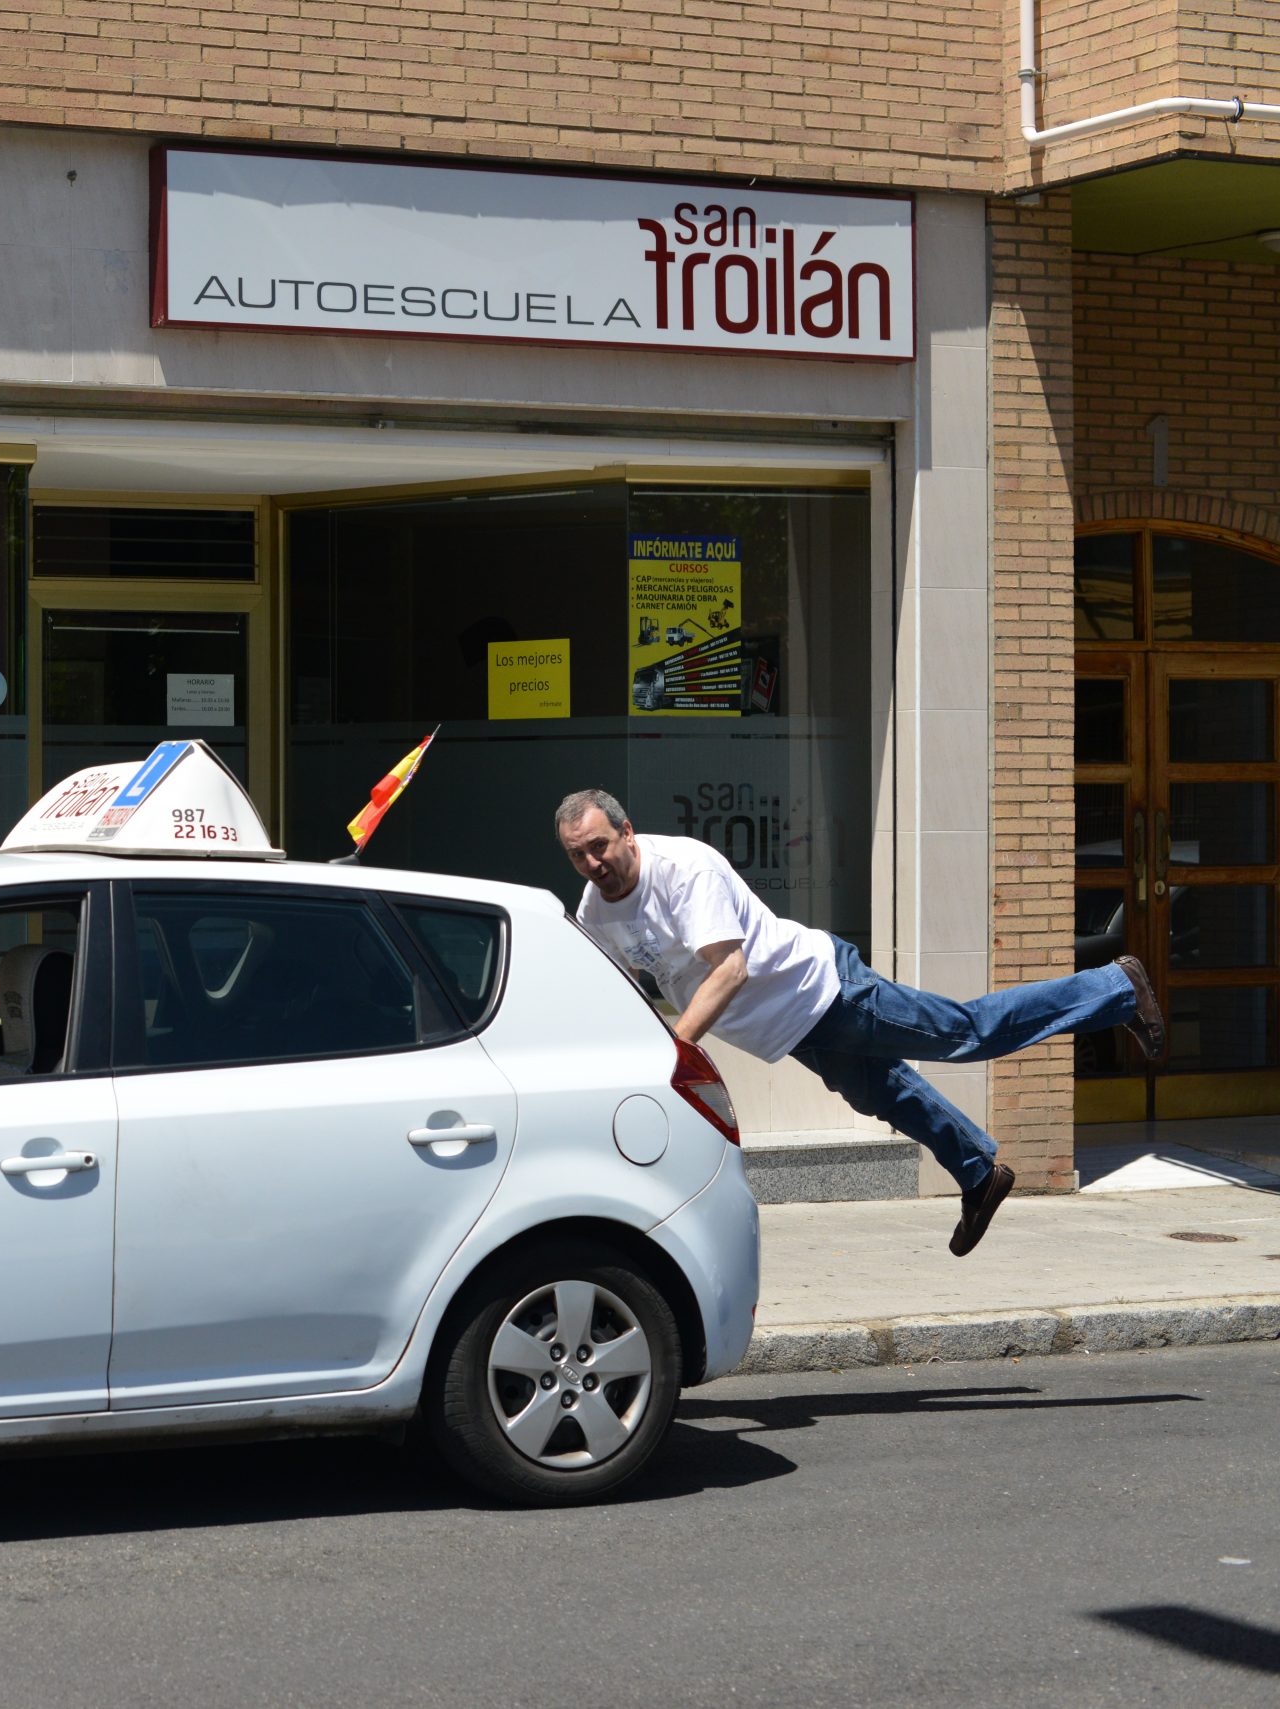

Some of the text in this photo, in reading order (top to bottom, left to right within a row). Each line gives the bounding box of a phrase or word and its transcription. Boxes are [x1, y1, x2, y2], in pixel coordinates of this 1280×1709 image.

[674, 202, 757, 249] san
[193, 217, 891, 341] AUTOESCUELA froilán
[634, 537, 736, 560] INFÓRMATE AQUÍ
[670, 563, 709, 574] CURSOS
[636, 575, 652, 583] CAP
[636, 584, 734, 593] MERCANCÍAS PELIGROSAS
[636, 594, 717, 602] MAQUINARIA DE OBRA
[666, 602, 697, 610] CAMIÓN
[496, 652, 563, 669] Los mejores
[509, 679, 550, 695] precios
[126, 753, 165, 797] L
[698, 783, 754, 811] san
[172, 808, 205, 823] 987
[173, 824, 238, 842] 22 16 33
